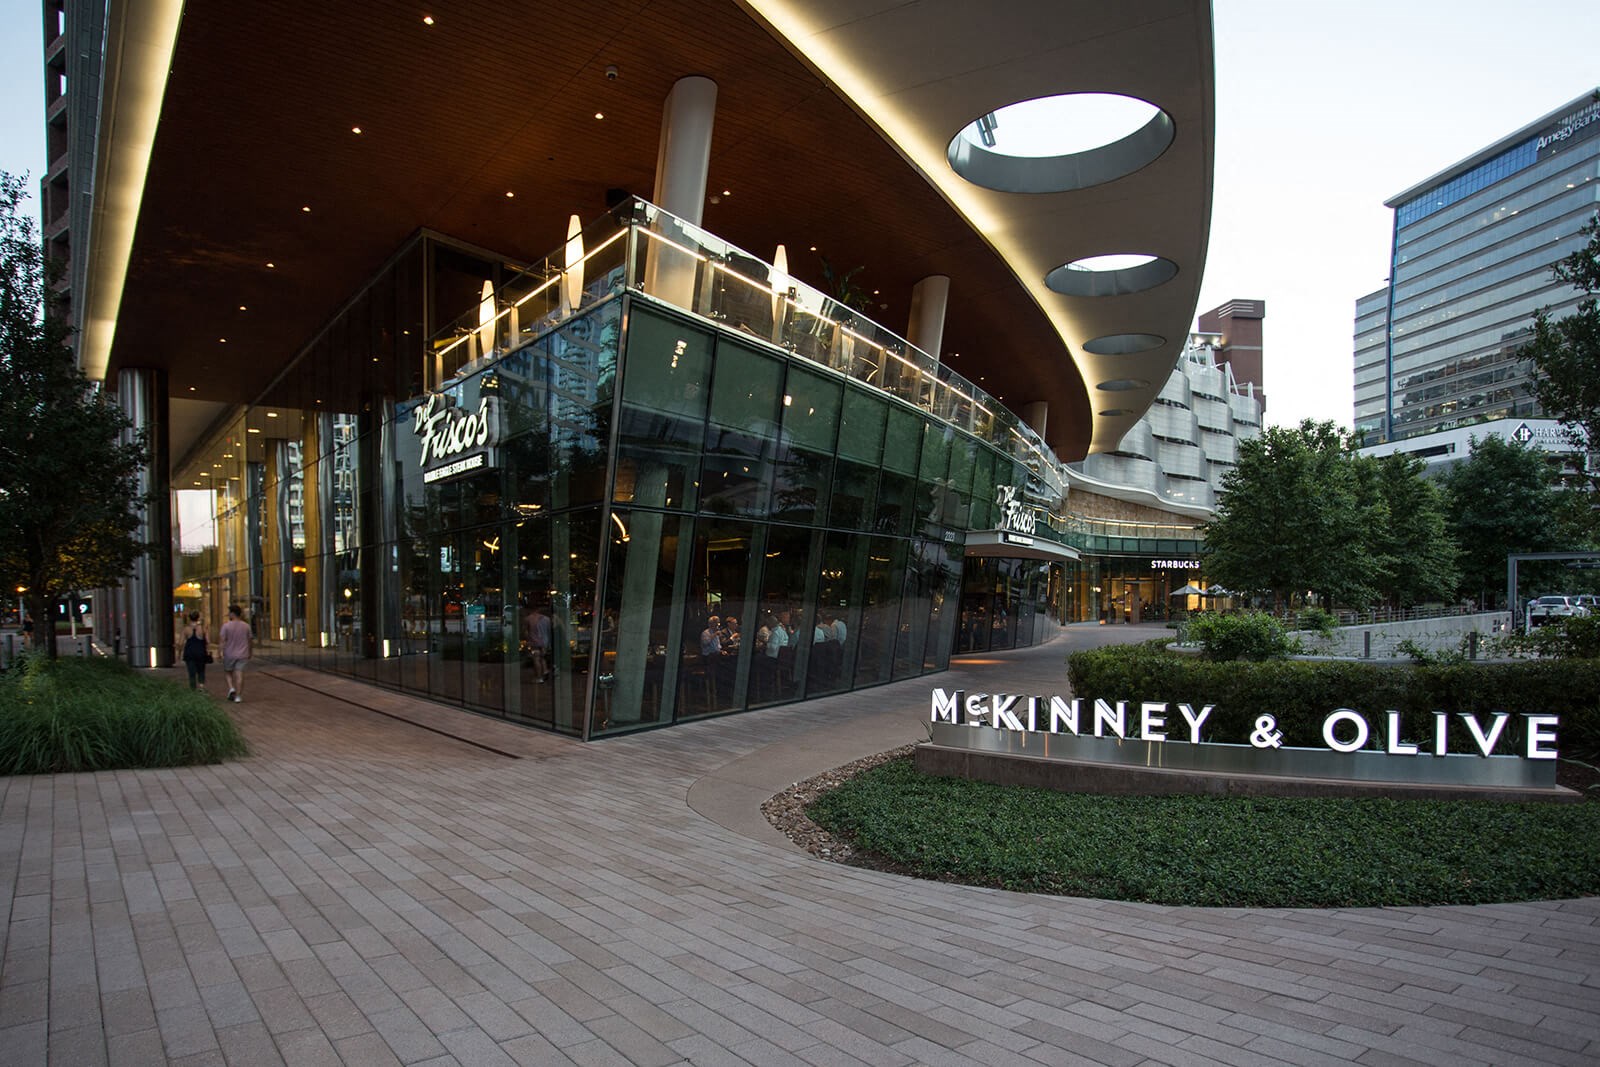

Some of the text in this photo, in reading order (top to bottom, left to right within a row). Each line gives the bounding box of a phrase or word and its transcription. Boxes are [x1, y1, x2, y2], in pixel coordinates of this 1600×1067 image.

[414, 394, 435, 433] Del
[420, 397, 488, 466] Frisco's
[1151, 560, 1200, 569] STARBUCKS
[1250, 713, 1283, 749] &
[1322, 708, 1559, 760] OLIVE
